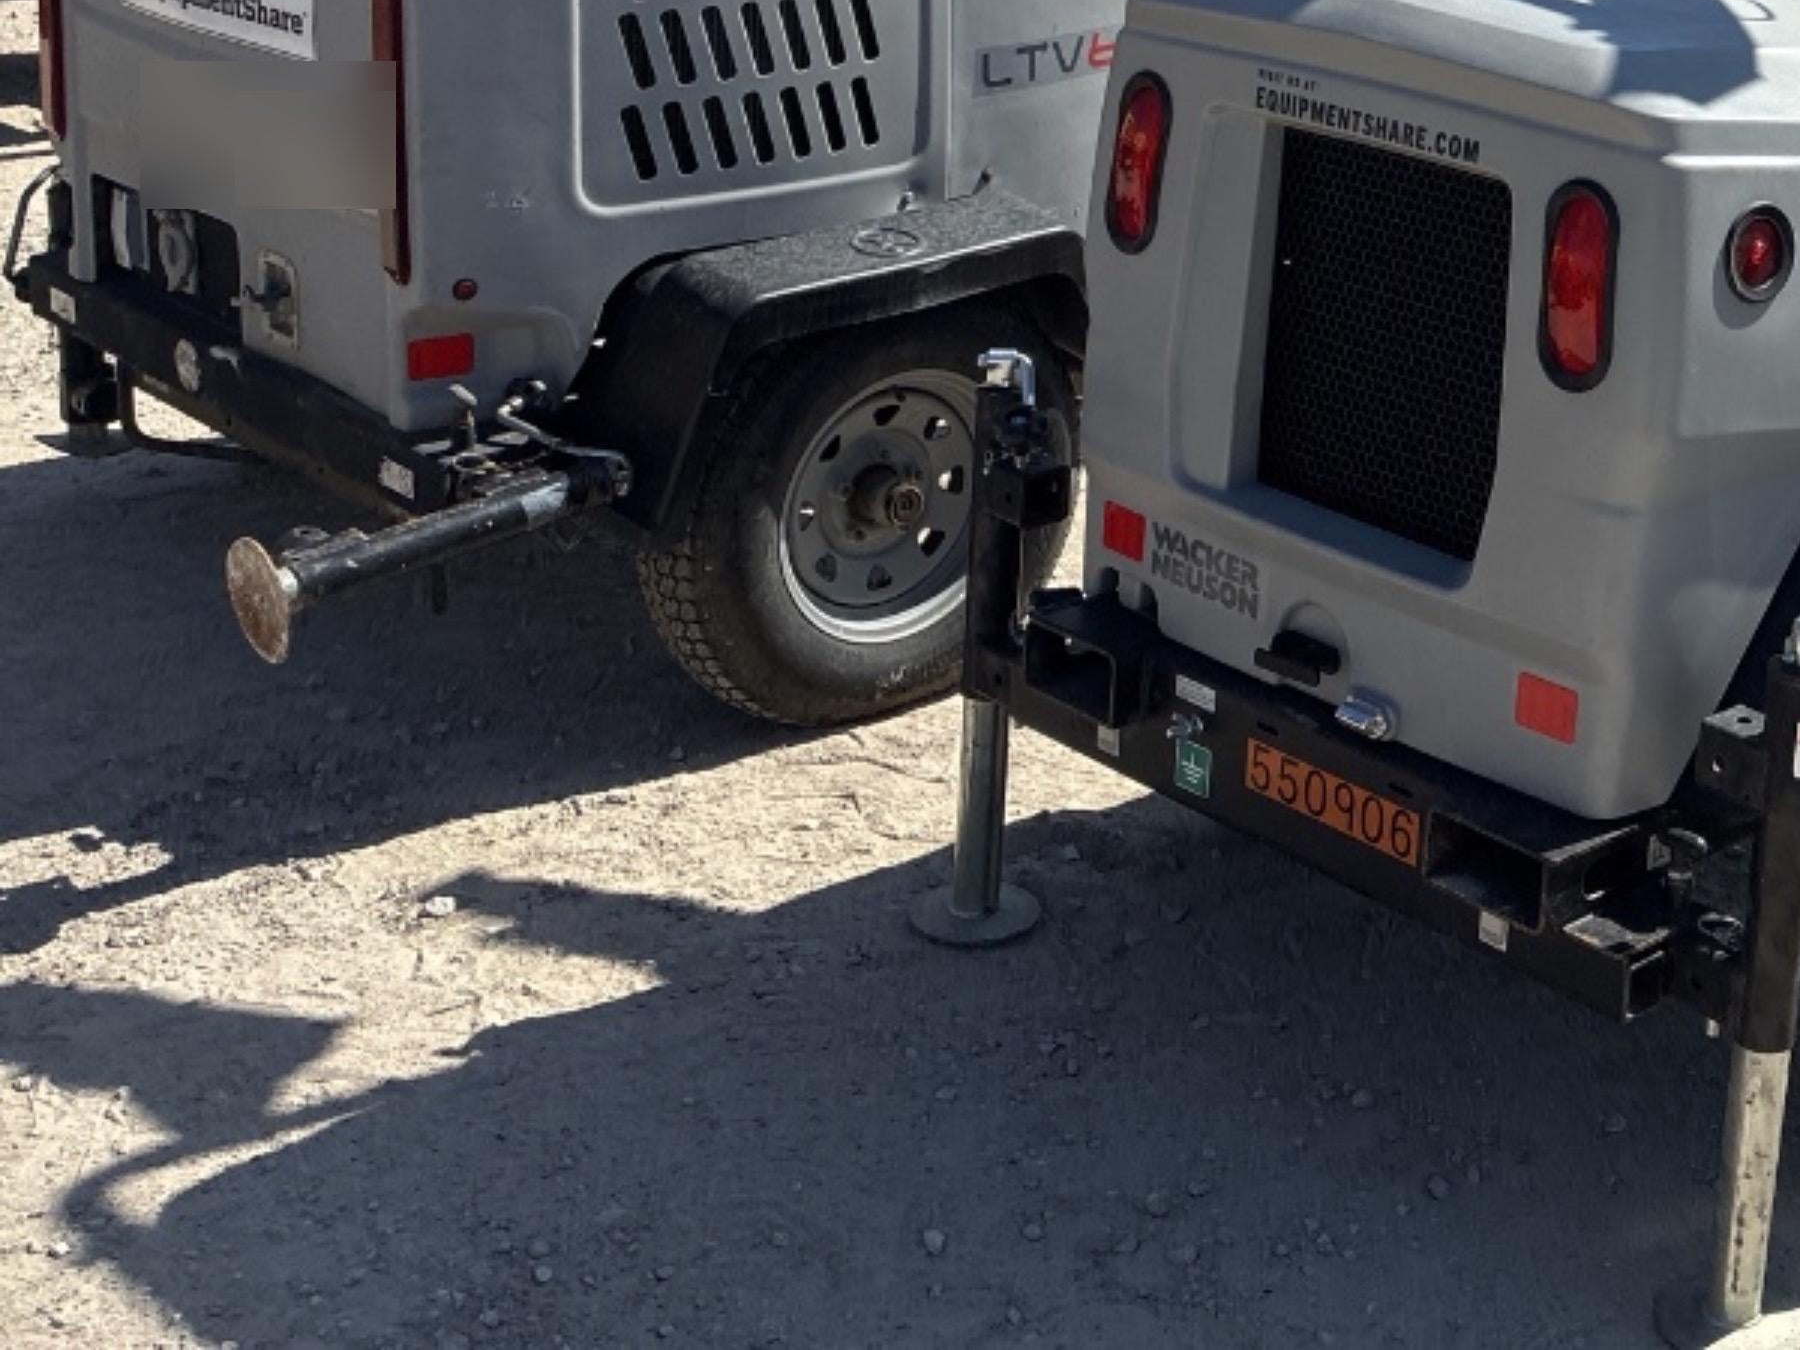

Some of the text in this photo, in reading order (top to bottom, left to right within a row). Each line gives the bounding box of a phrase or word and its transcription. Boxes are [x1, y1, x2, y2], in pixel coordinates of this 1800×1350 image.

[1256, 86, 1480, 163] EQUIPMENTSHARE.COM
[1151, 521, 1258, 592] WACKER
[1151, 549, 1258, 620] NEUSON
[1251, 744, 1413, 858] 550906
